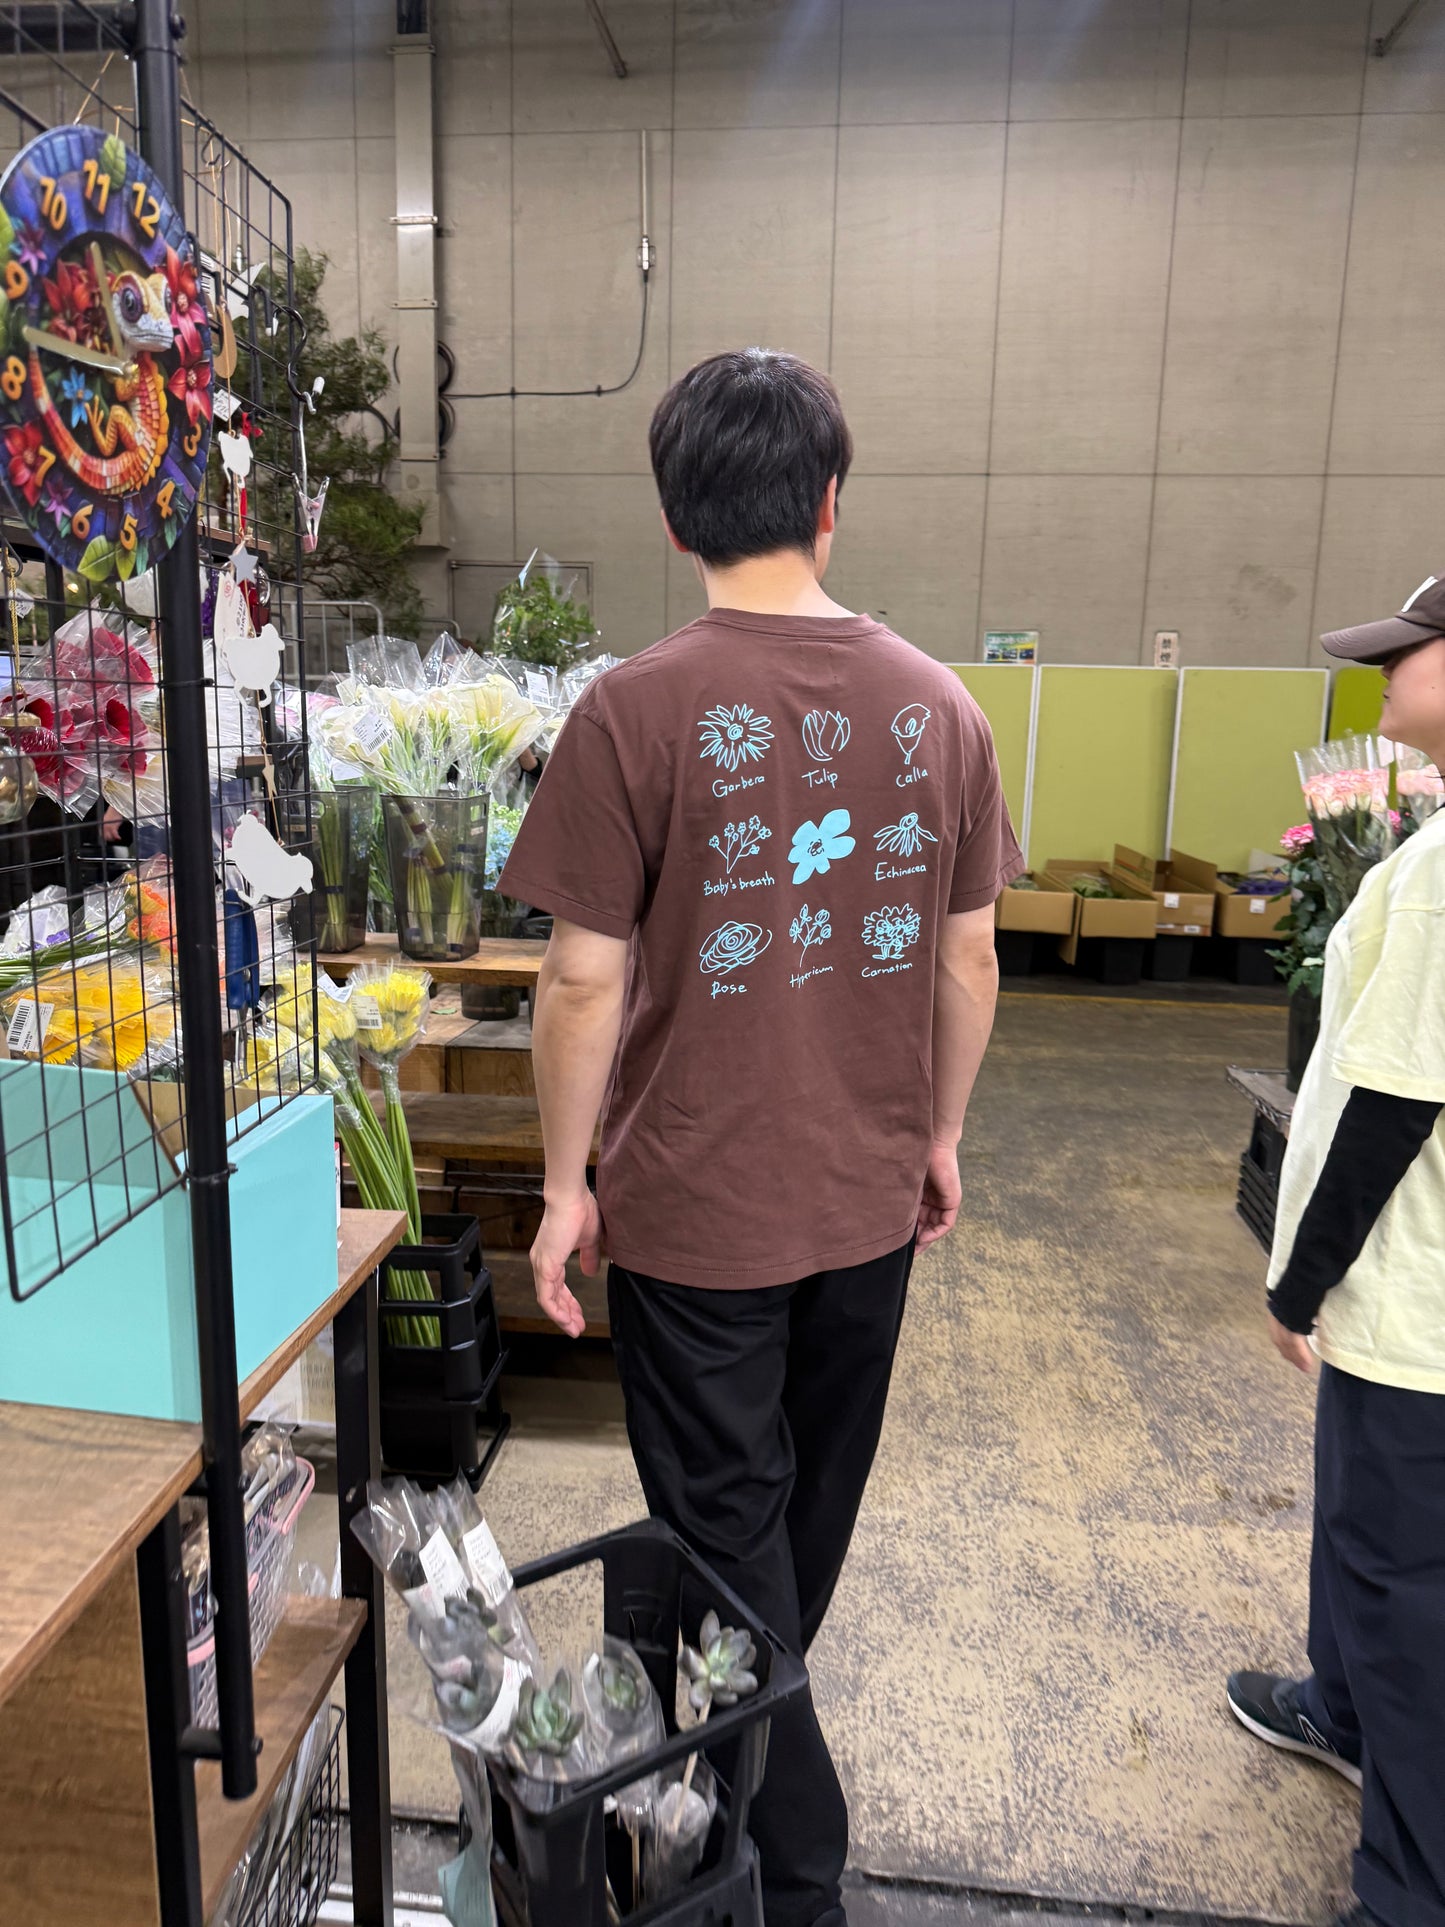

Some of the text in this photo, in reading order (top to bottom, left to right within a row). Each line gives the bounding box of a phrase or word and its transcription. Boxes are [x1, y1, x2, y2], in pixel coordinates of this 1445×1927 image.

[40, 176, 67, 231] 10
[83, 159, 111, 215] 11
[132, 182, 161, 239] 12
[5, 260, 29, 299] 9
[2, 355, 27, 401] 8
[183, 422, 202, 458] 3
[35, 445, 57, 488] 7
[156, 480, 176, 519] 4
[71, 503, 95, 540] 6
[120, 513, 139, 551] 5
[801, 768, 838, 789] Tulip
[703, 870, 775, 897] Baby's breath
[861, 962, 913, 978] Carnation
[710, 980, 748, 1000] Rose
